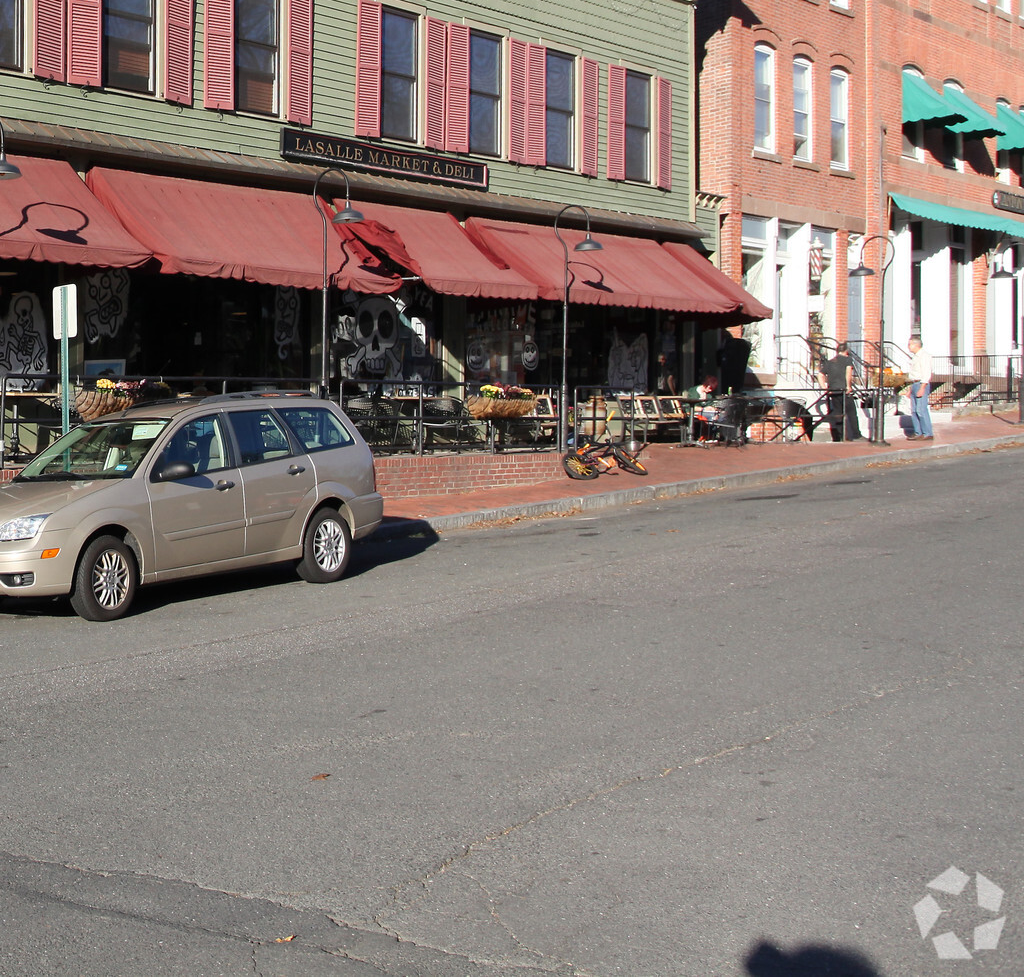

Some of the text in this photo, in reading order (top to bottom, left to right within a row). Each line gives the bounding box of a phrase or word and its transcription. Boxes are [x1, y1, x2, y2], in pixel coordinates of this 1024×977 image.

[296, 137, 474, 179] LASALLE MARKET & DELI
